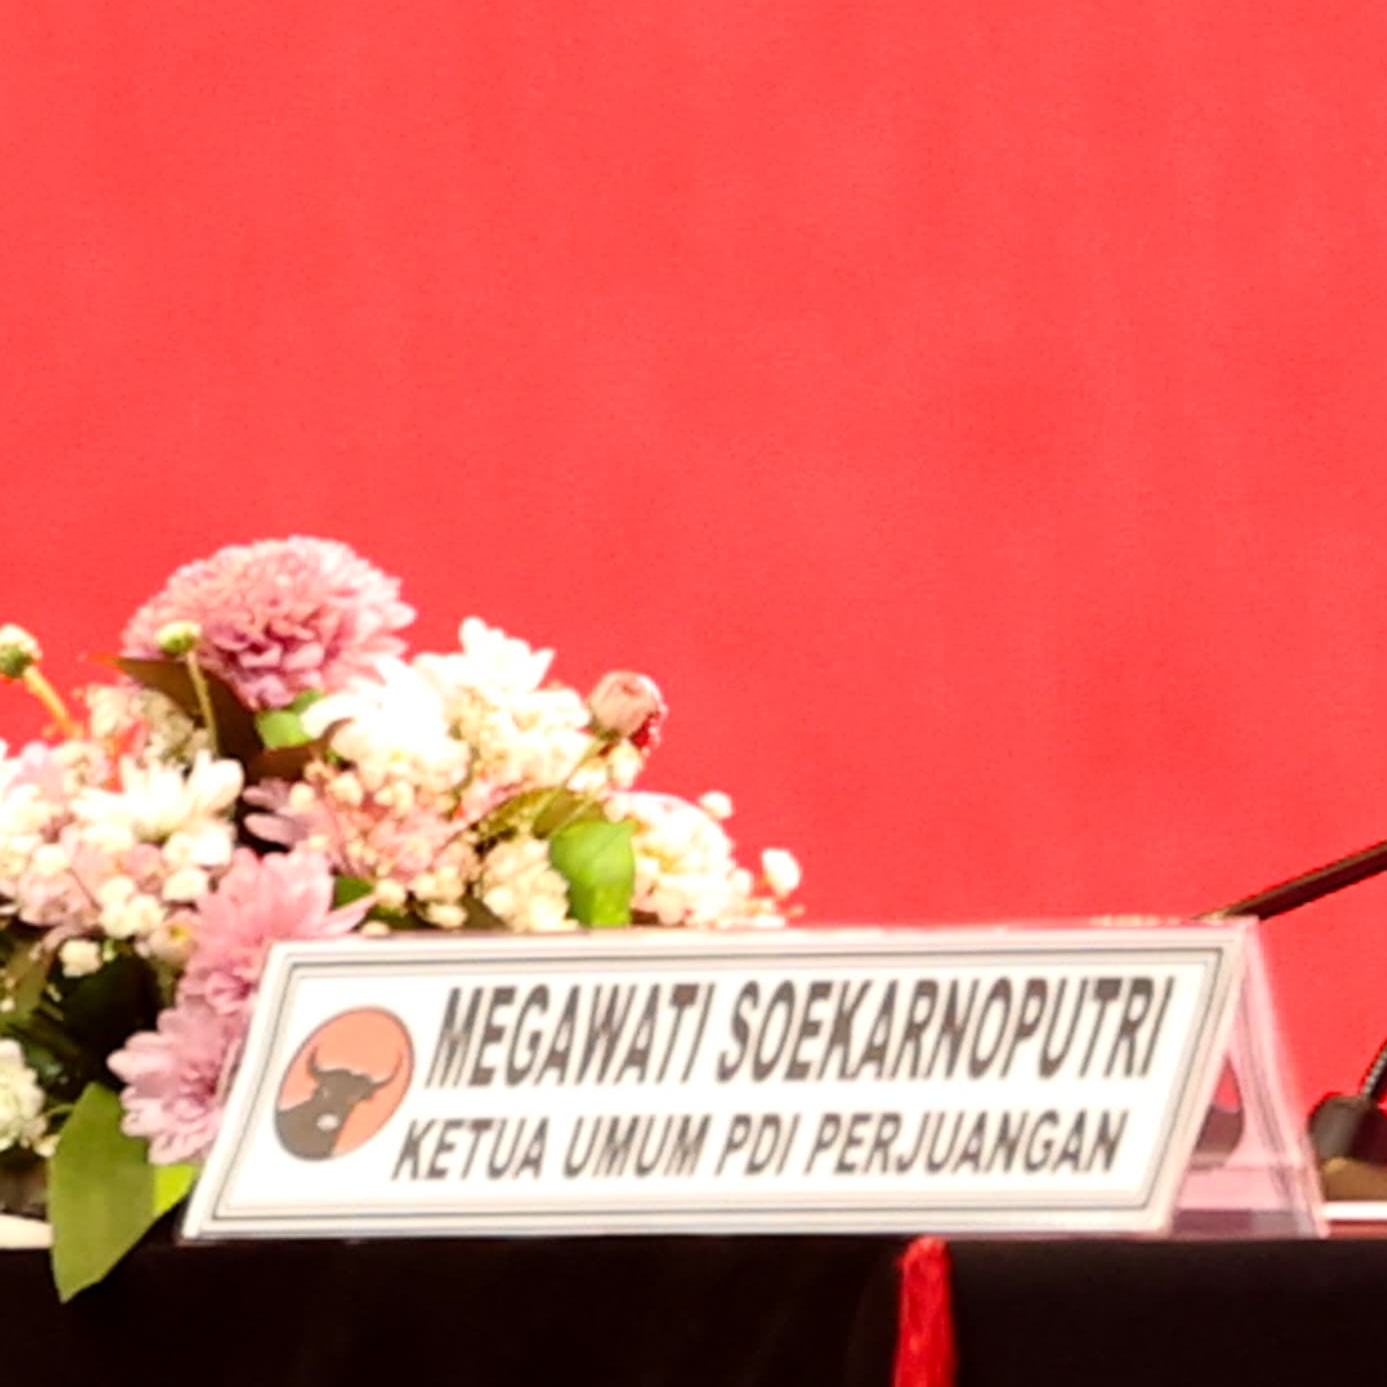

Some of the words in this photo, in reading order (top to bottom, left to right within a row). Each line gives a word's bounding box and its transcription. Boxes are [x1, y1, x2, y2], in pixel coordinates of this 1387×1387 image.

[424, 982, 716, 1088] MEGAWATI
[718, 976, 1175, 1083] SOEKARNOPUTRI
[393, 1116, 547, 1181] KETUA
[563, 1113, 709, 1176] UMUM
[715, 1112, 801, 1176] PDI
[804, 1110, 1129, 1175] PERJUANGAN
